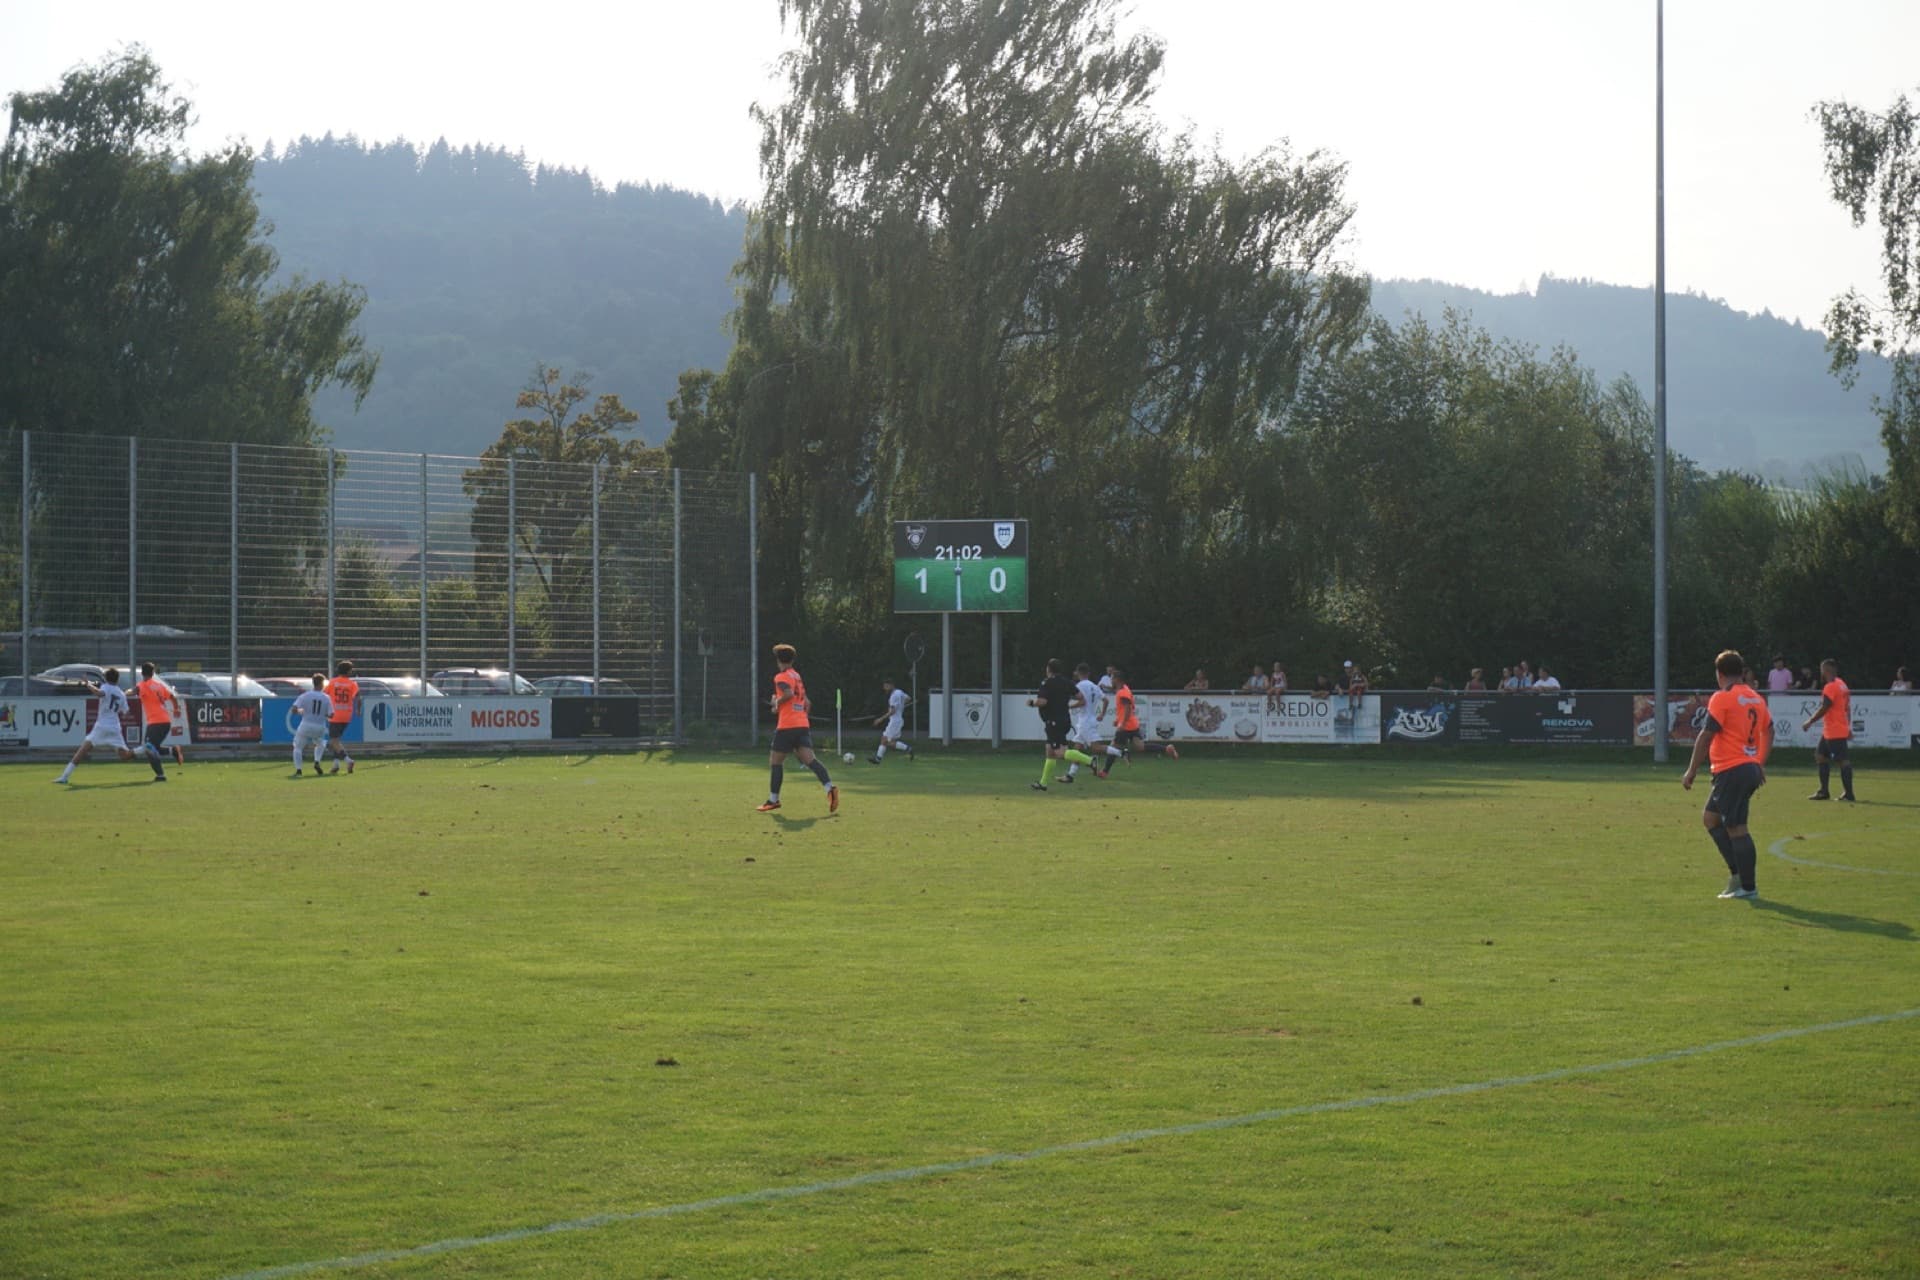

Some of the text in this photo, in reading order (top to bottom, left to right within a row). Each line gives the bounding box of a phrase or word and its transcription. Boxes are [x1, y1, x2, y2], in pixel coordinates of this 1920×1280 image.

[935, 545, 982, 560] 21:02
[914, 567, 928, 594] 1
[990, 567, 1006, 593] 0
[312, 699, 321, 715] 11
[397, 703, 453, 717] HÜRLIMANN
[33, 708, 80, 732] nay.
[397, 717, 453, 728] INFORMATIK
[471, 710, 540, 728] MIGROS
[1541, 719, 1594, 727] RENOVA
